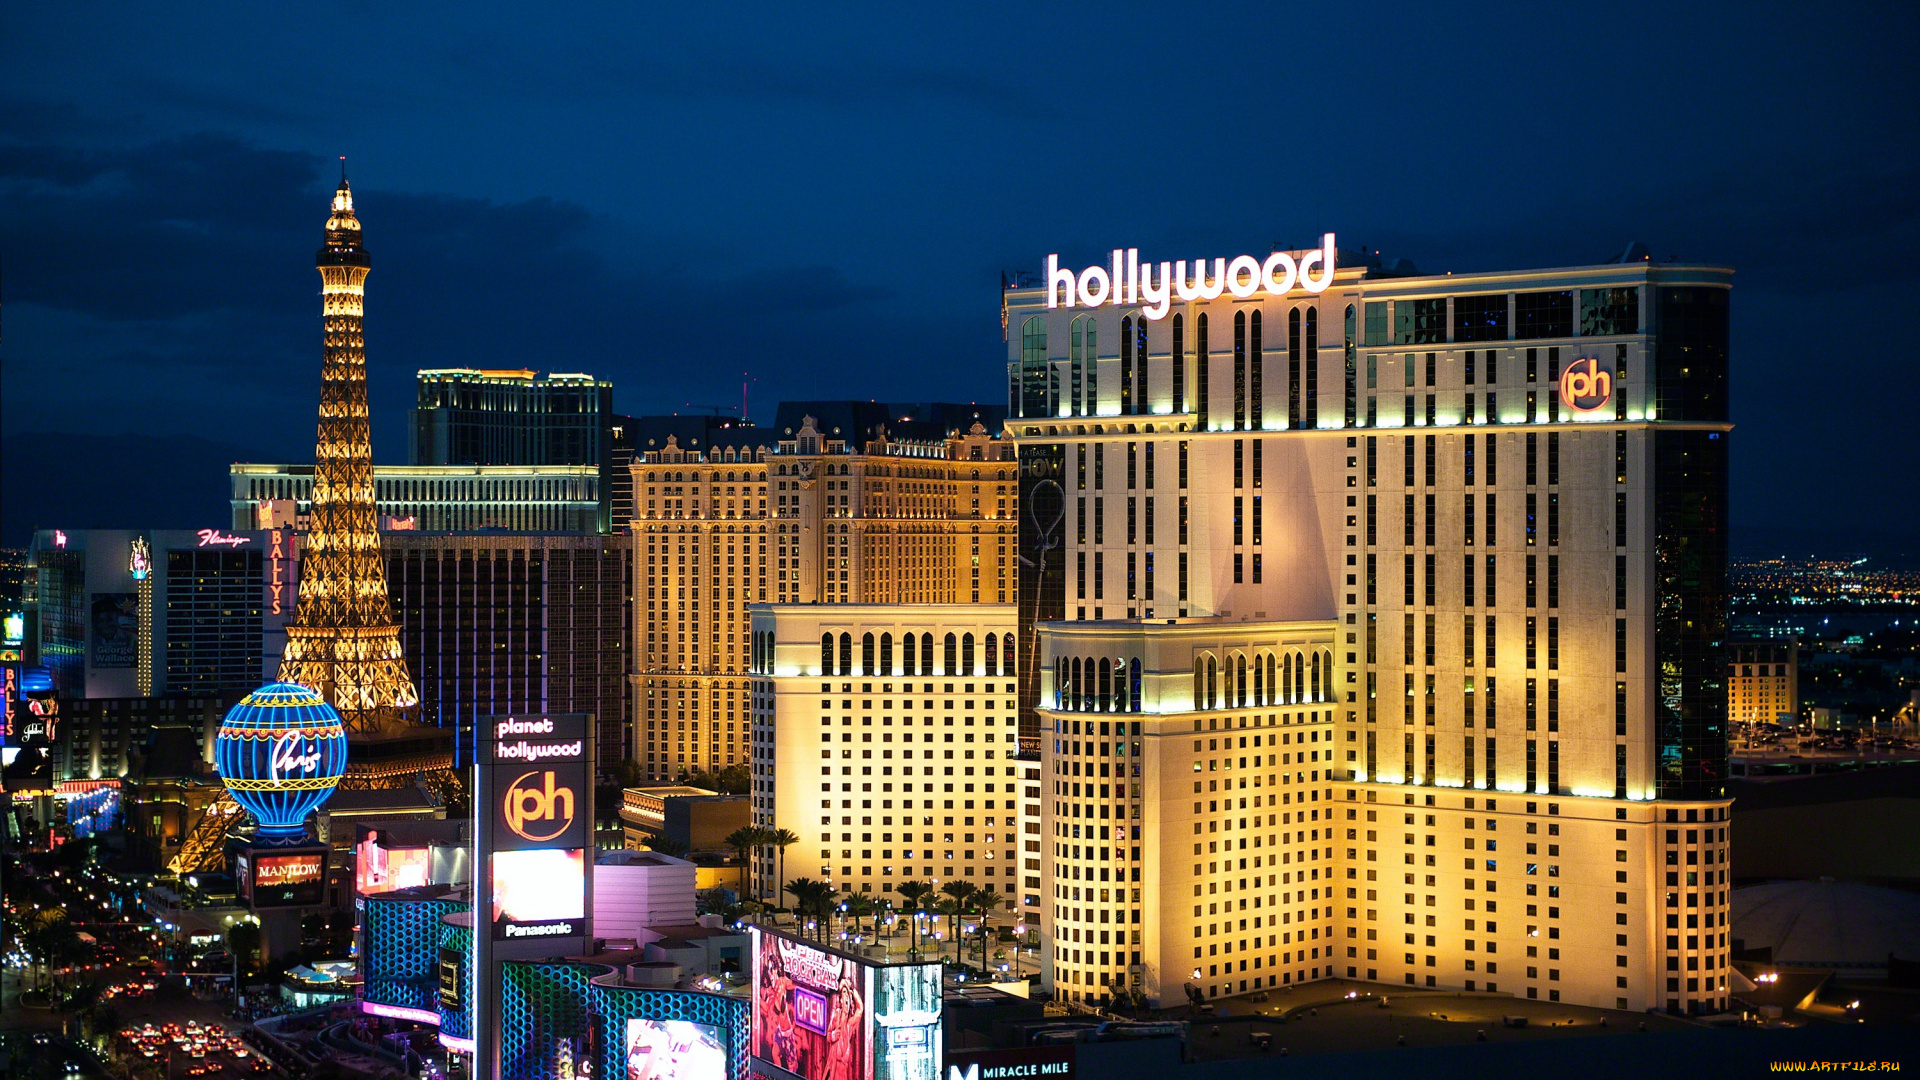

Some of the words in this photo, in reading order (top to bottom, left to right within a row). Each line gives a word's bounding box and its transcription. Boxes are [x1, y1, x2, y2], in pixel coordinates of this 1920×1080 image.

[1047, 232, 1335, 320] hollywood
[1566, 358, 1611, 405] ph
[197, 529, 250, 548] Flamingo
[270, 530, 284, 615] BALLYS
[95, 654, 135, 662] Wallace
[97, 646, 133, 655] George
[5, 668, 15, 736] BALLYS
[498, 718, 554, 738] planet
[271, 730, 321, 787] Paris
[498, 741, 582, 761] hollywood
[512, 771, 574, 834] ph
[506, 922, 572, 937] Panasonic
[784, 956, 814, 985] ROCK
[815, 966, 839, 991] BAR
[796, 995, 825, 1029] OPEN
[983, 1065, 1037, 1078] MIRACLE
[1041, 1062, 1069, 1074] MILE
